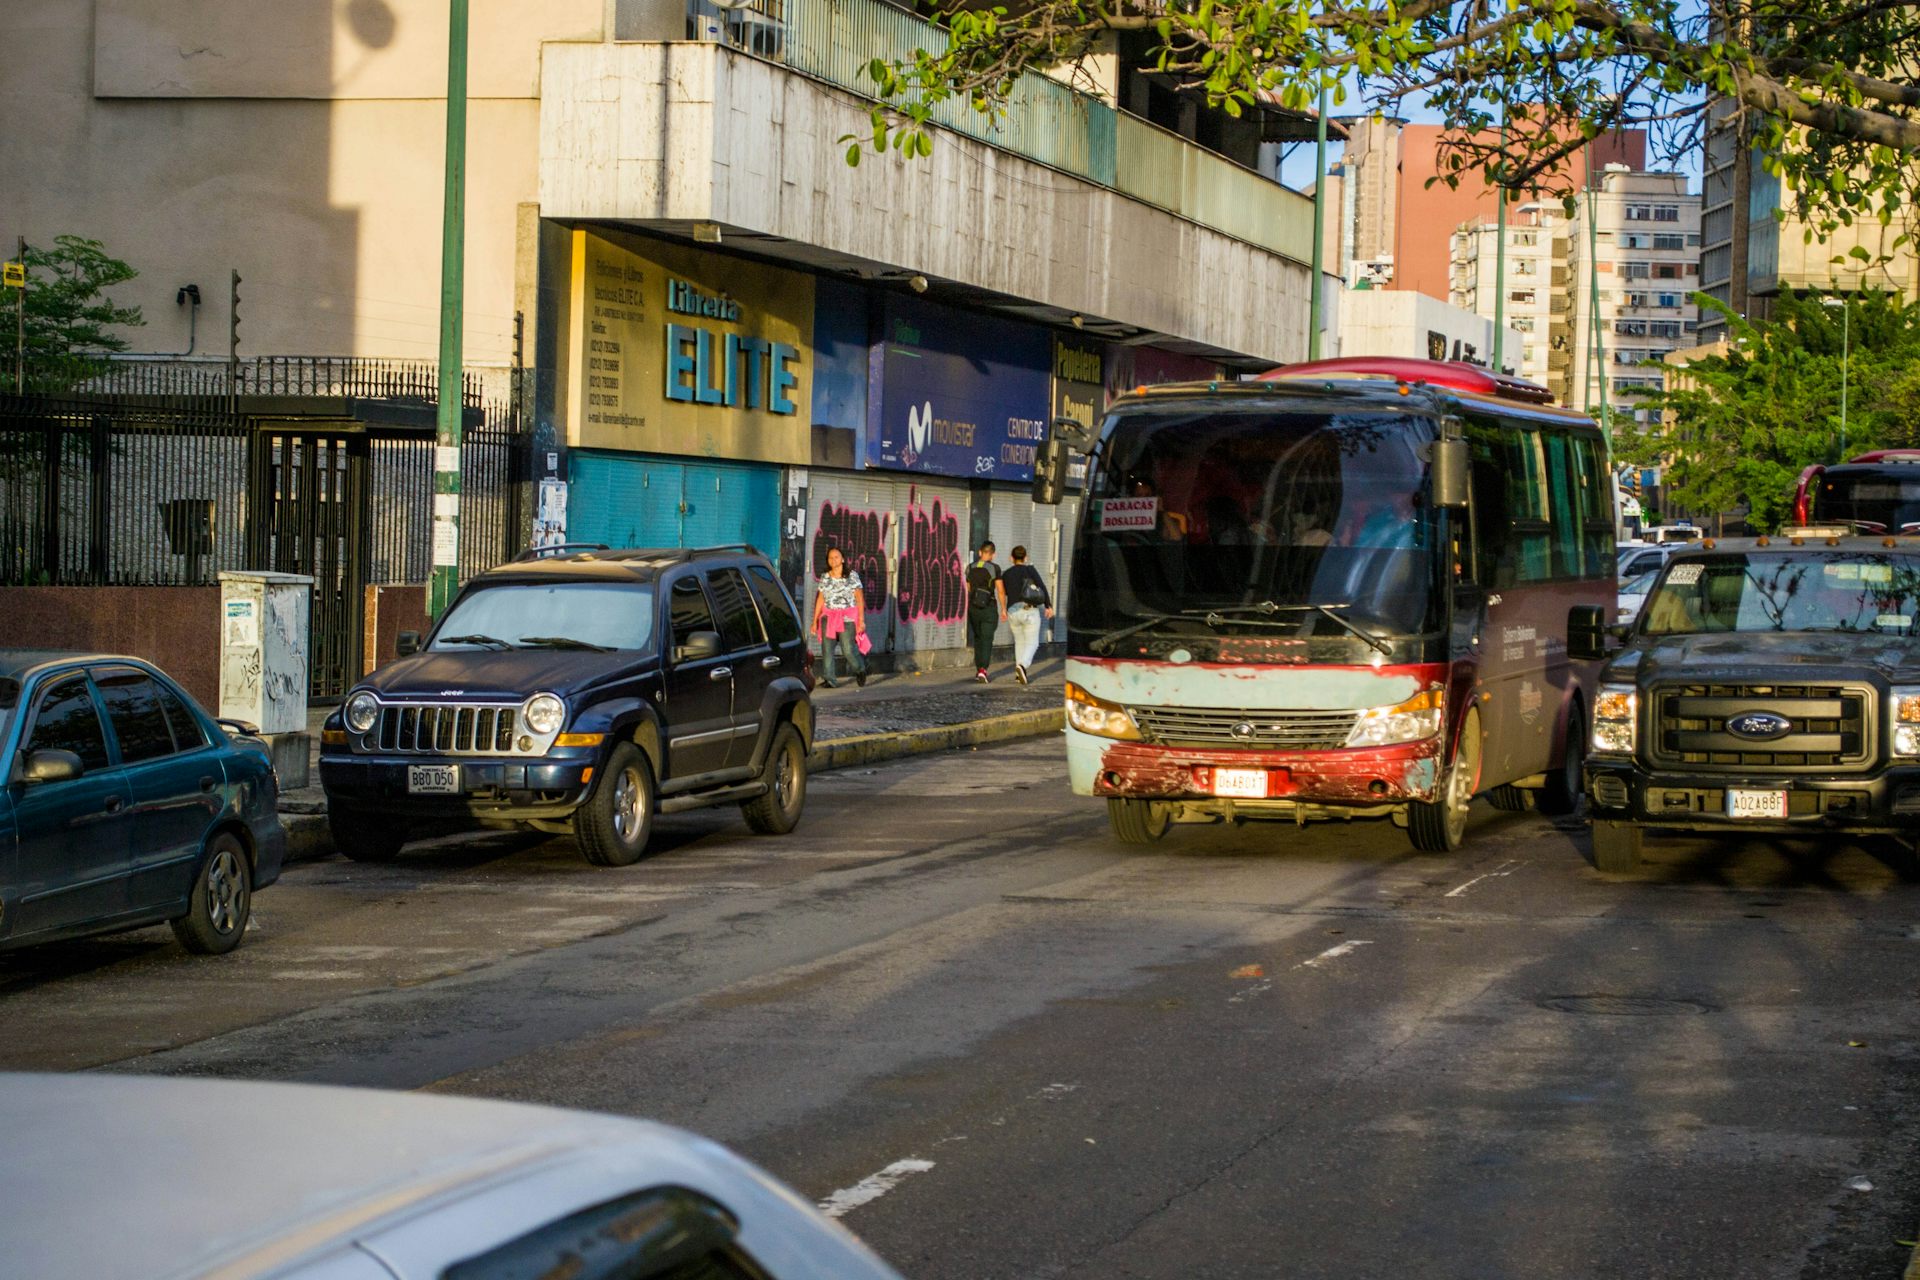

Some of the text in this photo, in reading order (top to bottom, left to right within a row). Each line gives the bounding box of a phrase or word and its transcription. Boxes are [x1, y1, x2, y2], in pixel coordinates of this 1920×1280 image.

[666, 323, 796, 414] ELITE
[1008, 417, 1043, 441] CENTRO DE
[1105, 501, 1154, 511] CARACAS
[1104, 516, 1153, 526] ROSALEDA
[1741, 717, 1777, 733] Ford
